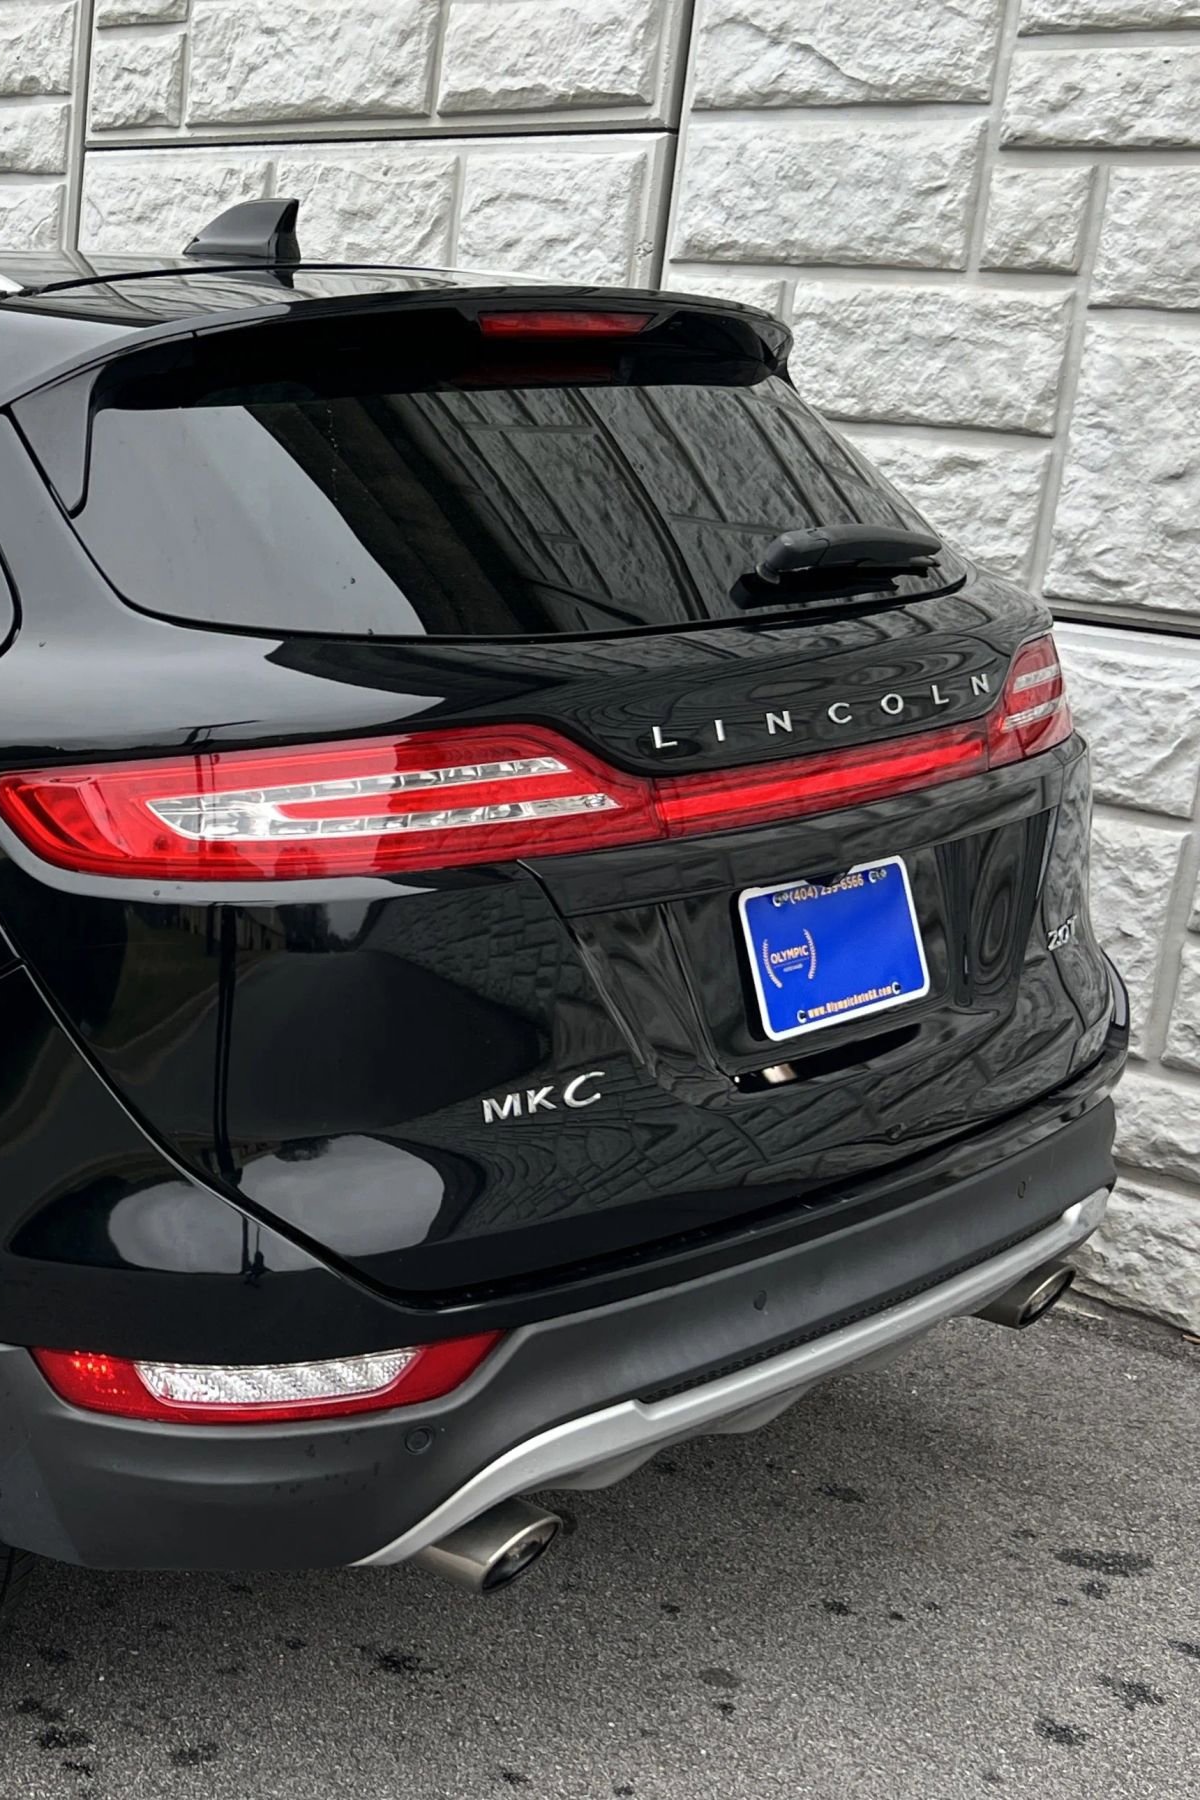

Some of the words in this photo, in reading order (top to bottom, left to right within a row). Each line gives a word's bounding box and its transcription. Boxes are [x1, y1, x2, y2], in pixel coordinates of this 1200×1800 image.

[652, 673, 991, 750] LINCOLN
[789, 885, 819, 905] (404)
[770, 944, 809, 965] OLYMPIC
[482, 1071, 606, 1124] MKC
